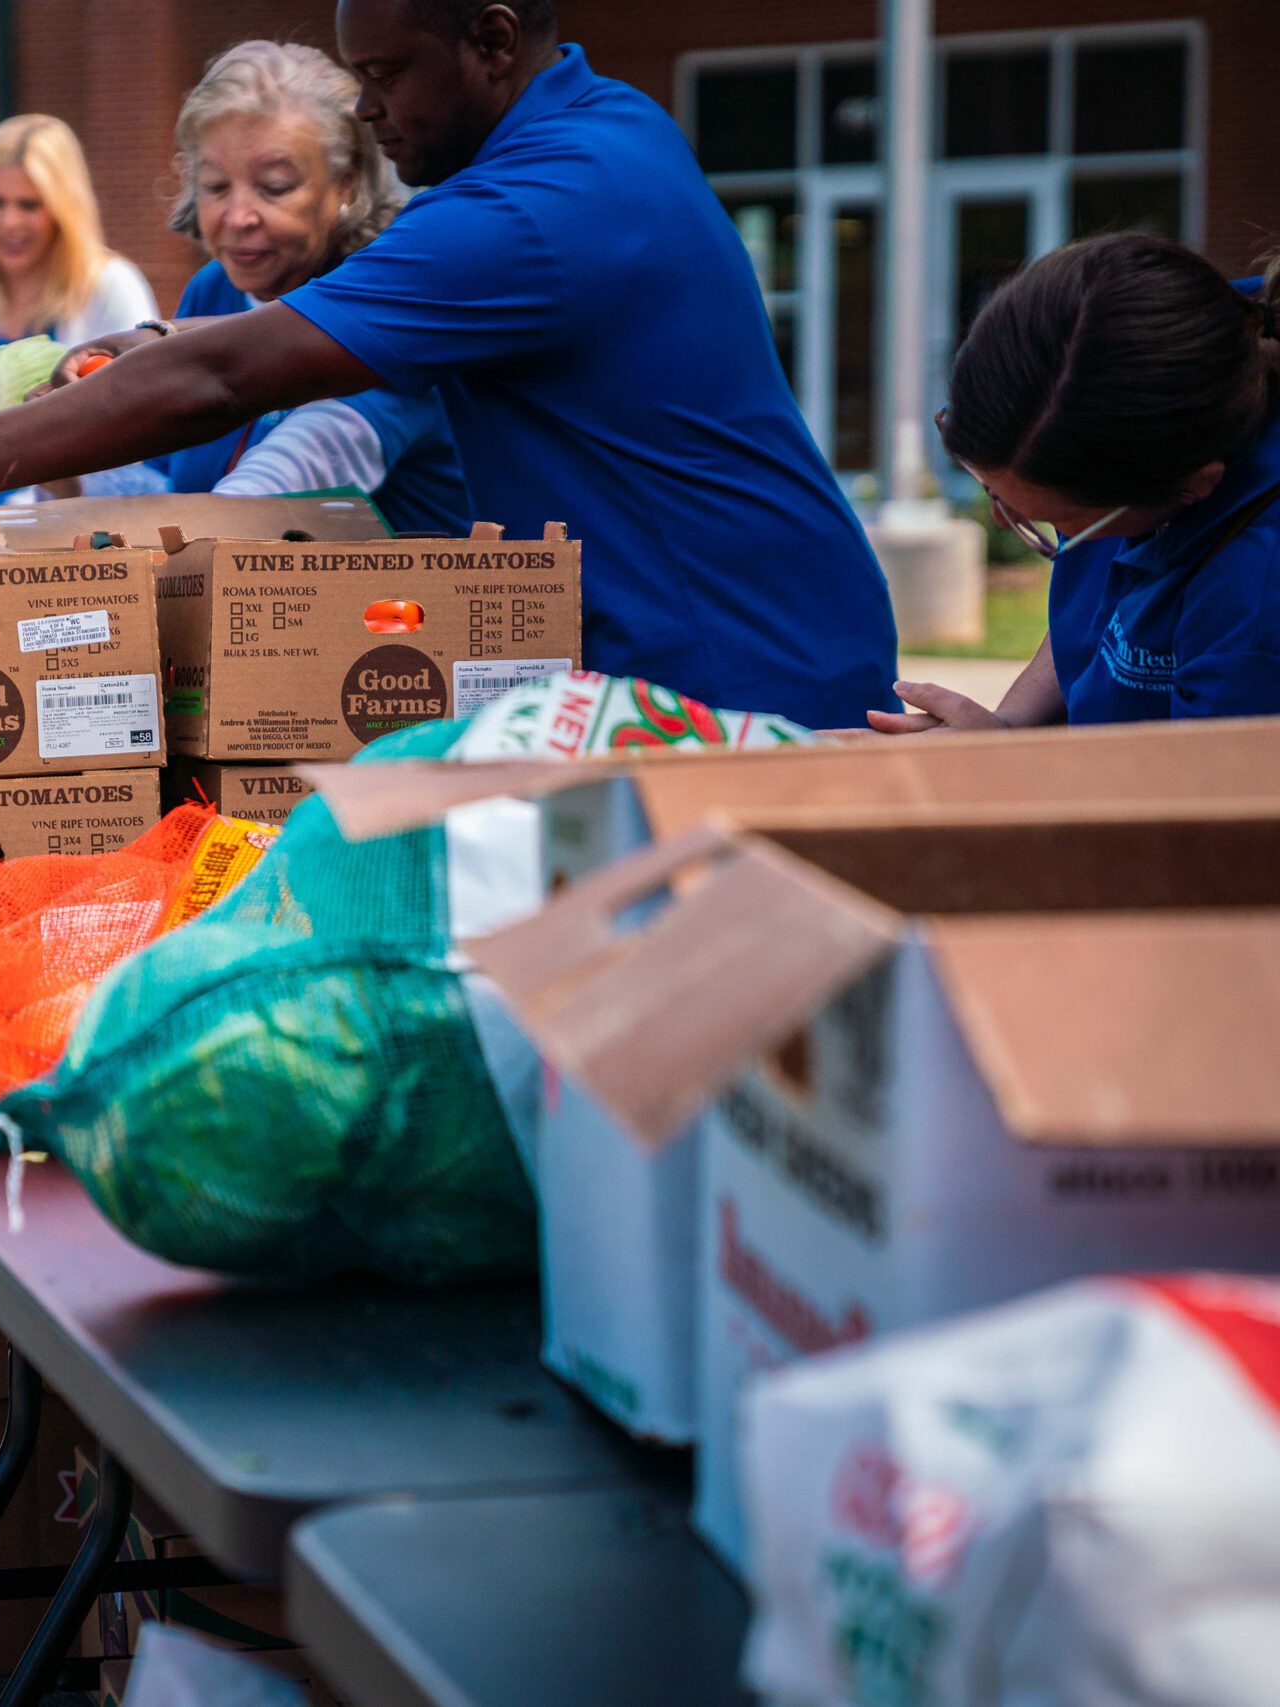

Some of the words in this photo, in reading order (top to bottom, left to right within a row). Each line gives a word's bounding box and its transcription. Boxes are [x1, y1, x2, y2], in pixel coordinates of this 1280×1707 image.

[232, 554, 294, 572] VINE
[301, 553, 414, 571] RIPENED
[422, 551, 556, 570] TOMATOES
[157, 574, 205, 599] TOMATOES
[454, 584, 481, 594] VINE
[483, 584, 505, 594] RIPE
[507, 583, 565, 594] TOMATOES
[222, 587, 257, 597] ROMA
[260, 586, 317, 596] TOMATOES
[28, 598, 54, 608] VINE
[56, 596, 80, 607] RIPE
[81, 594, 139, 606] TOMATOES
[484, 601, 503, 610] 3X4
[526, 601, 545, 610] 5X6
[245, 604, 264, 613] XXL
[287, 603, 310, 612] MED
[108, 612, 120, 621] X6
[484, 616, 503, 625] 4X4
[526, 616, 545, 625] 6X6
[245, 619, 258, 627] XL
[288, 618, 303, 627] SM
[109, 627, 121, 635] X6
[484, 630, 503, 639] 4X5
[526, 630, 545, 639] 6X7
[245, 632, 260, 642] LG
[103, 641, 120, 651] 6X7
[484, 645, 503, 654] 5X5
[223, 649, 247, 657] BULK
[250, 649, 261, 657] 25
[263, 648, 282, 657] LBS.
[284, 648, 301, 657] NET
[303, 648, 319, 657] WT.
[61, 658, 79, 668] 5X5
[357, 669, 431, 692] Good
[346, 694, 442, 716] Farms
[253, 718, 290, 726] Williamson
[139, 732, 152, 742] 58
[306, 742, 331, 750] MEXICO
[239, 777, 303, 796] VINE
[231, 809, 265, 820] ROMA
[31, 820, 58, 831] VINE
[59, 818, 83, 829] RIPE
[85, 816, 144, 828] TOMATOES
[63, 836, 81, 846] 3X4
[106, 834, 125, 844] 5X6
